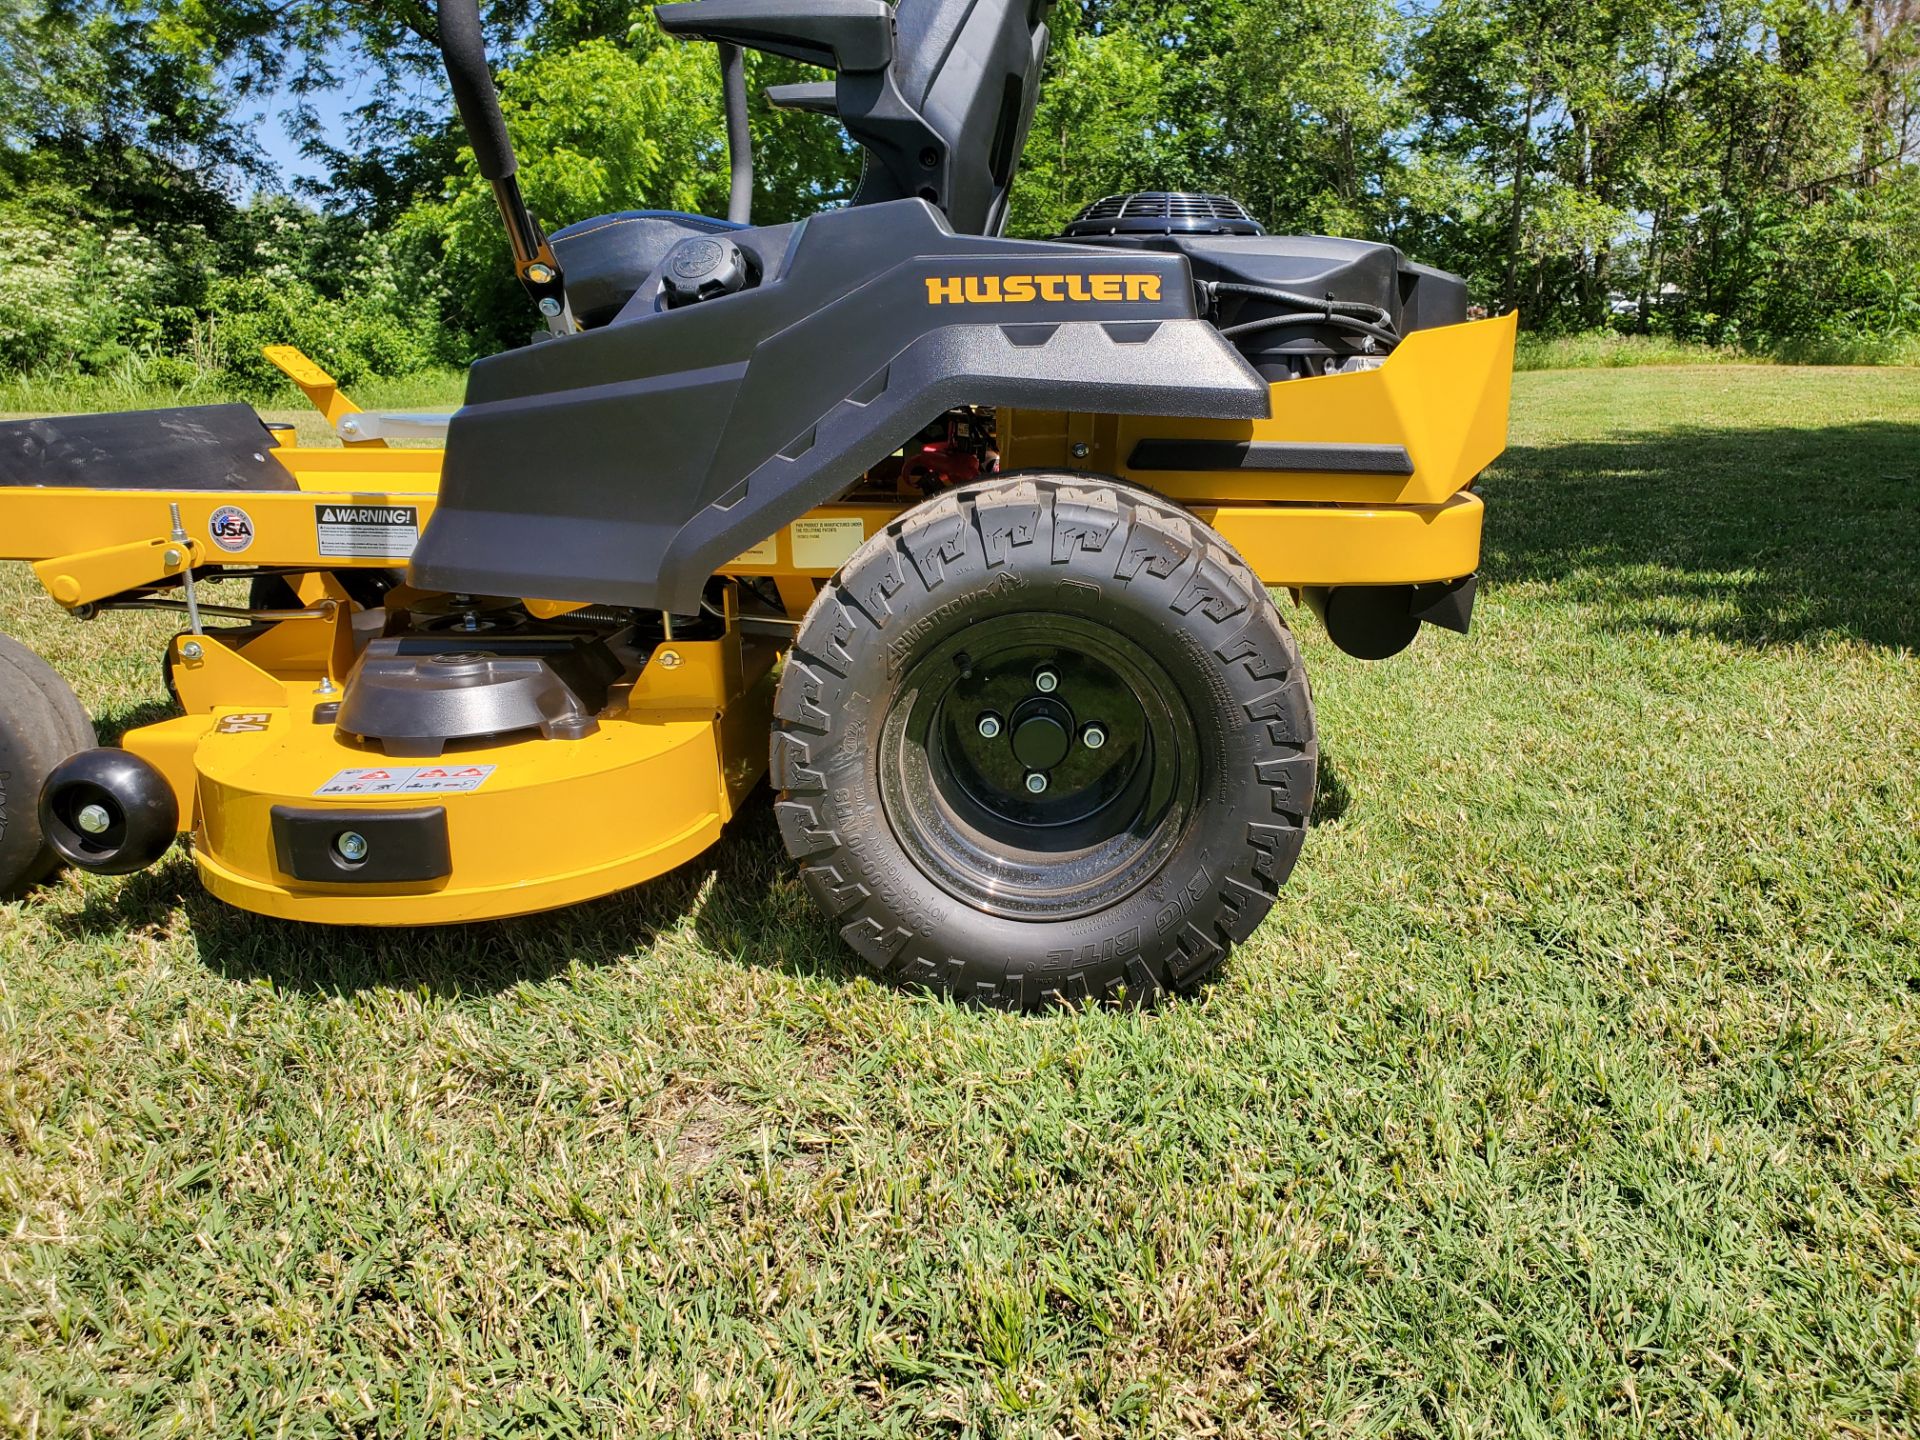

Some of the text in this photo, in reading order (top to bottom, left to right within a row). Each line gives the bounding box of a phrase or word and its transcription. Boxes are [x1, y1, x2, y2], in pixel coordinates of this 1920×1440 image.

[925, 274, 1161, 304] HUSTLER
[213, 509, 227, 522] MADE
[236, 510, 247, 521] THE
[336, 508, 411, 524] WARNING!
[211, 522, 252, 537] USA
[215, 713, 272, 734] 54
[834, 788, 857, 834] NHS
[868, 832, 905, 886] HIGHWAY
[902, 882, 925, 906] FOR
[1154, 864, 1213, 937] BIG
[923, 902, 950, 923] NOT
[1042, 925, 1140, 971] BITE
